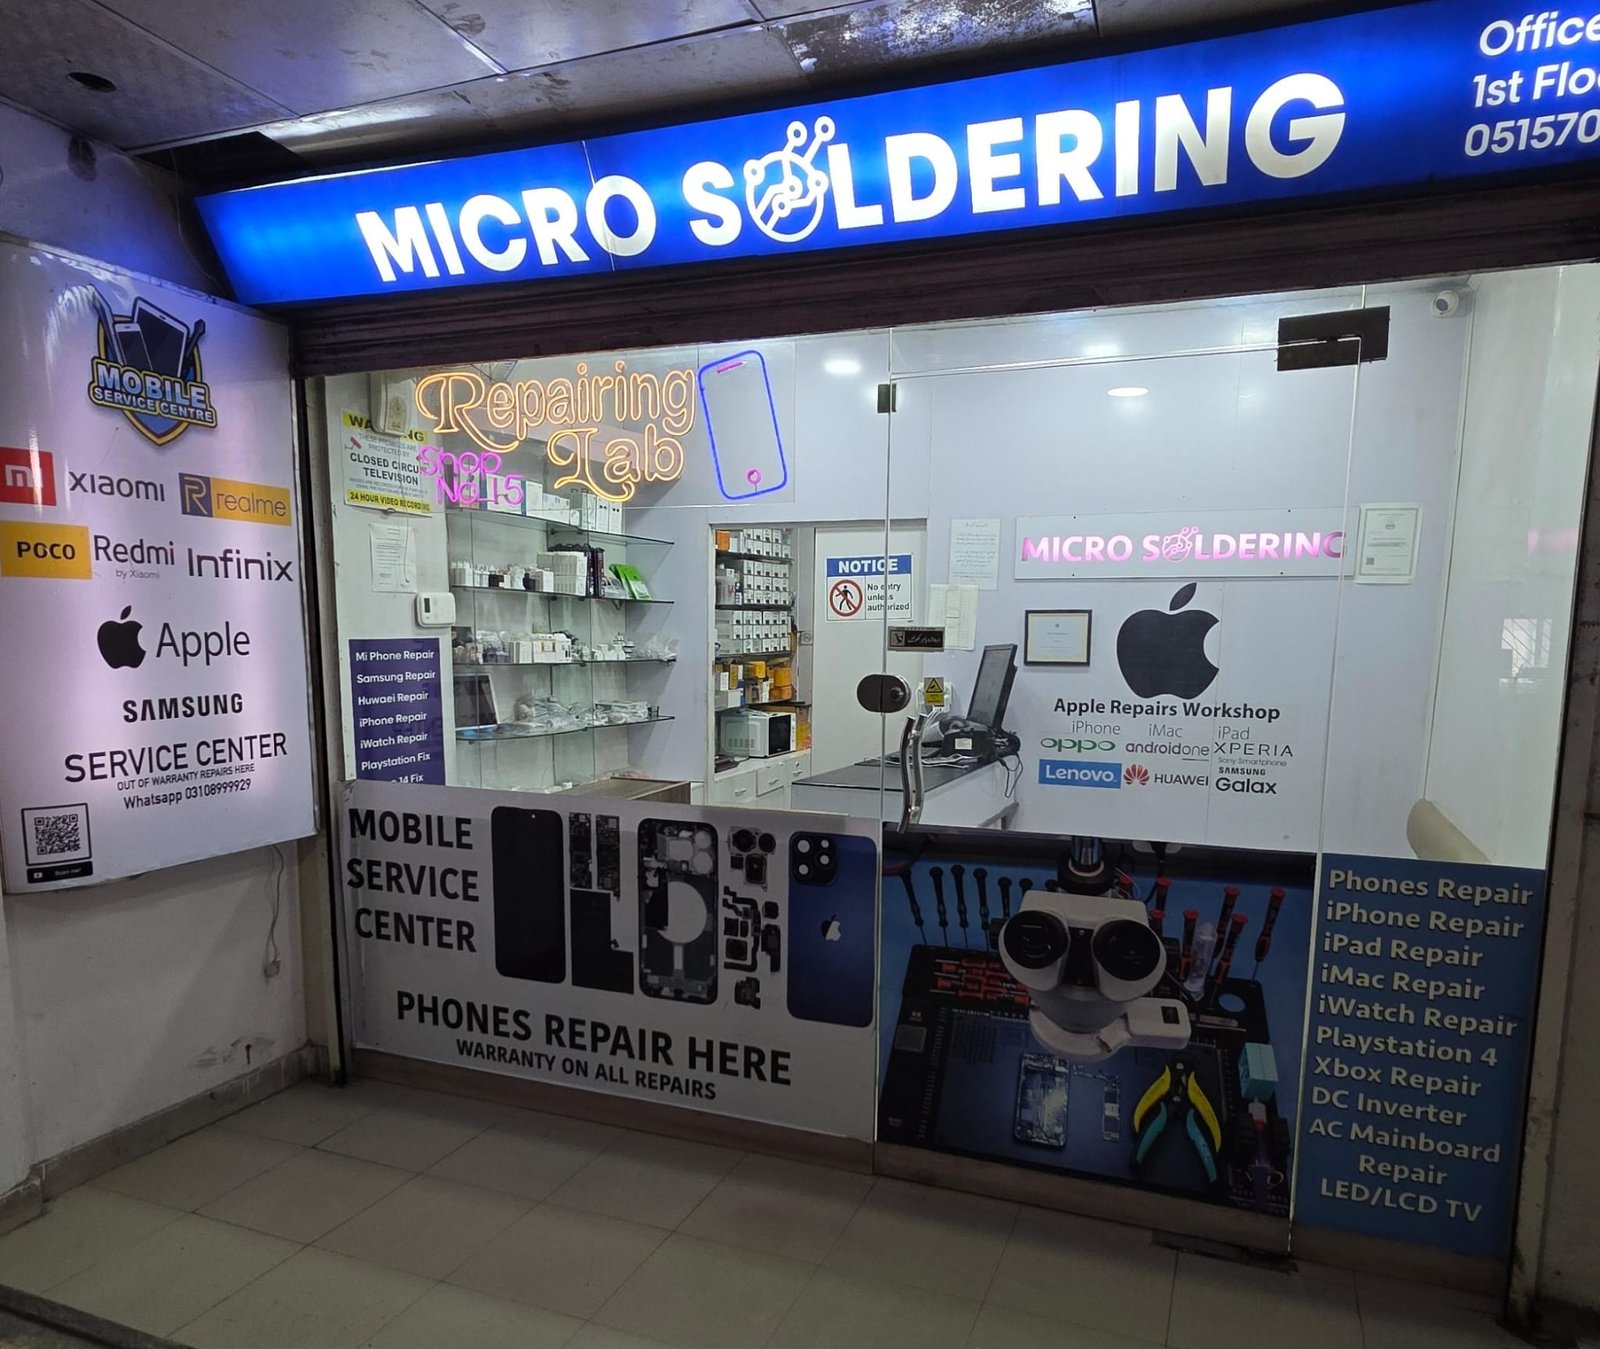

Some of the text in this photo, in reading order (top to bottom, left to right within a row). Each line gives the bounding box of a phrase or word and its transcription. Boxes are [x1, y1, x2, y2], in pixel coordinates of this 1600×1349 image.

[1480, 11, 1600, 56] Office
[1473, 61, 1600, 108] 1st Flo
[1464, 109, 1600, 157] 051570
[355, 72, 1347, 282] MICRO SOLDERING
[97, 365, 207, 409] MOBILE
[93, 387, 214, 423] SERVICE CENTRE
[415, 360, 697, 452] Repairing
[348, 414, 425, 442] WANG
[350, 452, 389, 468] CLOSED
[418, 447, 502, 477] Shop
[547, 424, 685, 502] Lab
[363, 467, 418, 486] TELEVISION
[216, 492, 287, 518] realme
[350, 491, 359, 500] 24
[360, 493, 379, 503] HOUR
[380, 496, 399, 507] VIDEO
[16, 540, 76, 561] POCO
[93, 534, 175, 566] Redmi
[1021, 534, 1133, 562] MICRO
[115, 568, 160, 580] by Xiaomi
[187, 547, 294, 582] Infinix
[838, 558, 898, 573] NOTICE
[867, 593, 893, 601] unles
[867, 602, 910, 612] authrized
[156, 621, 250, 666] Apple
[355, 650, 435, 662] Mi Phone Repair
[356, 670, 436, 683] Samsung Repair
[123, 693, 244, 723] SAMSUNG
[358, 691, 429, 706] Huwaei Repair
[1054, 698, 1281, 723] Apple Repairs Workshop
[359, 711, 427, 727] iPhone Repair
[1072, 720, 1121, 735] iPhone
[1149, 723, 1183, 738] iMac
[1218, 726, 1250, 740] iPad
[360, 732, 428, 749] iWatch Repair
[1214, 741, 1293, 757] XPERIA
[64, 732, 288, 783] SERVICE CENTER
[361, 752, 431, 771] Playstation Fix
[1218, 757, 1287, 767] Sony Smartphone
[1218, 766, 1266, 776] SAMSUNG
[117, 763, 255, 791] OUT OF WARRANTY REPAIRS HERE
[410, 772, 424, 782] Fix
[1045, 764, 1115, 782] Lenovo
[1154, 773, 1209, 786] HUAWEI
[1215, 777, 1278, 795] Galax
[123, 778, 251, 809] Whatsapp 03108999929
[348, 807, 474, 850] MOBILE
[346, 857, 480, 902] SERVICE
[1329, 869, 1533, 907] Phones Repair
[354, 907, 477, 953] CENTER
[1325, 900, 1525, 939] iPhone Repair
[1323, 932, 1484, 968] iPad Repair
[1320, 963, 1486, 1000] iMac Repair
[1318, 994, 1519, 1037] iWatch Repair
[397, 990, 792, 1086] PHONES REPAIR HERE
[1316, 1025, 1498, 1067] Playstation 4
[456, 1038, 717, 1101] WARRANTY ON ALL REPAIRS
[1313, 1055, 1482, 1097] Xbox Repair
[1311, 1086, 1468, 1127] DC Inverter
[1308, 1118, 1501, 1164] AC Mainboard
[1358, 1154, 1449, 1186] Repair
[1320, 1177, 1439, 1214] LED/LCD
[1445, 1199, 1483, 1222] TV
